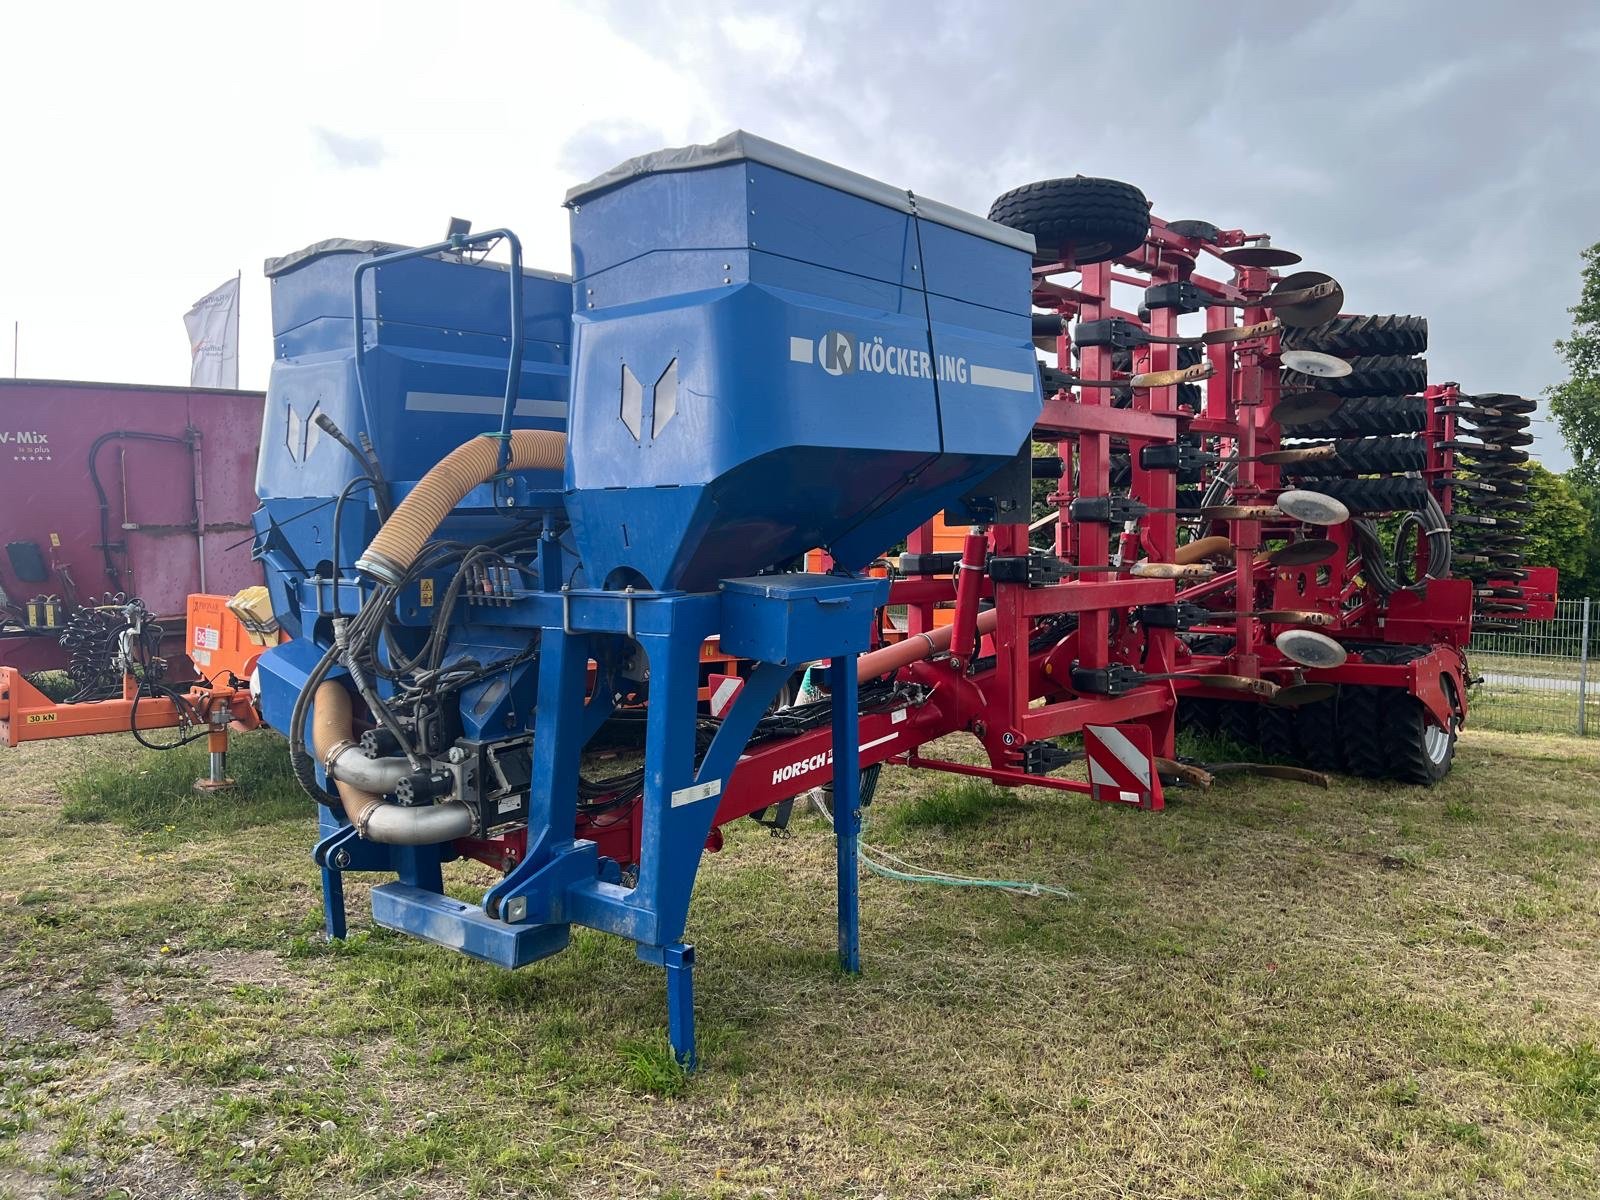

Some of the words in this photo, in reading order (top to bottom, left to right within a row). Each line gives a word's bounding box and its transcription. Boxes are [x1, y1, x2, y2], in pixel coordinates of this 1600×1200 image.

[34, 445, 50, 454] plus
[312, 524, 322, 544] 2
[621, 522, 630, 547] 1
[771, 752, 826, 785] HORSCH
